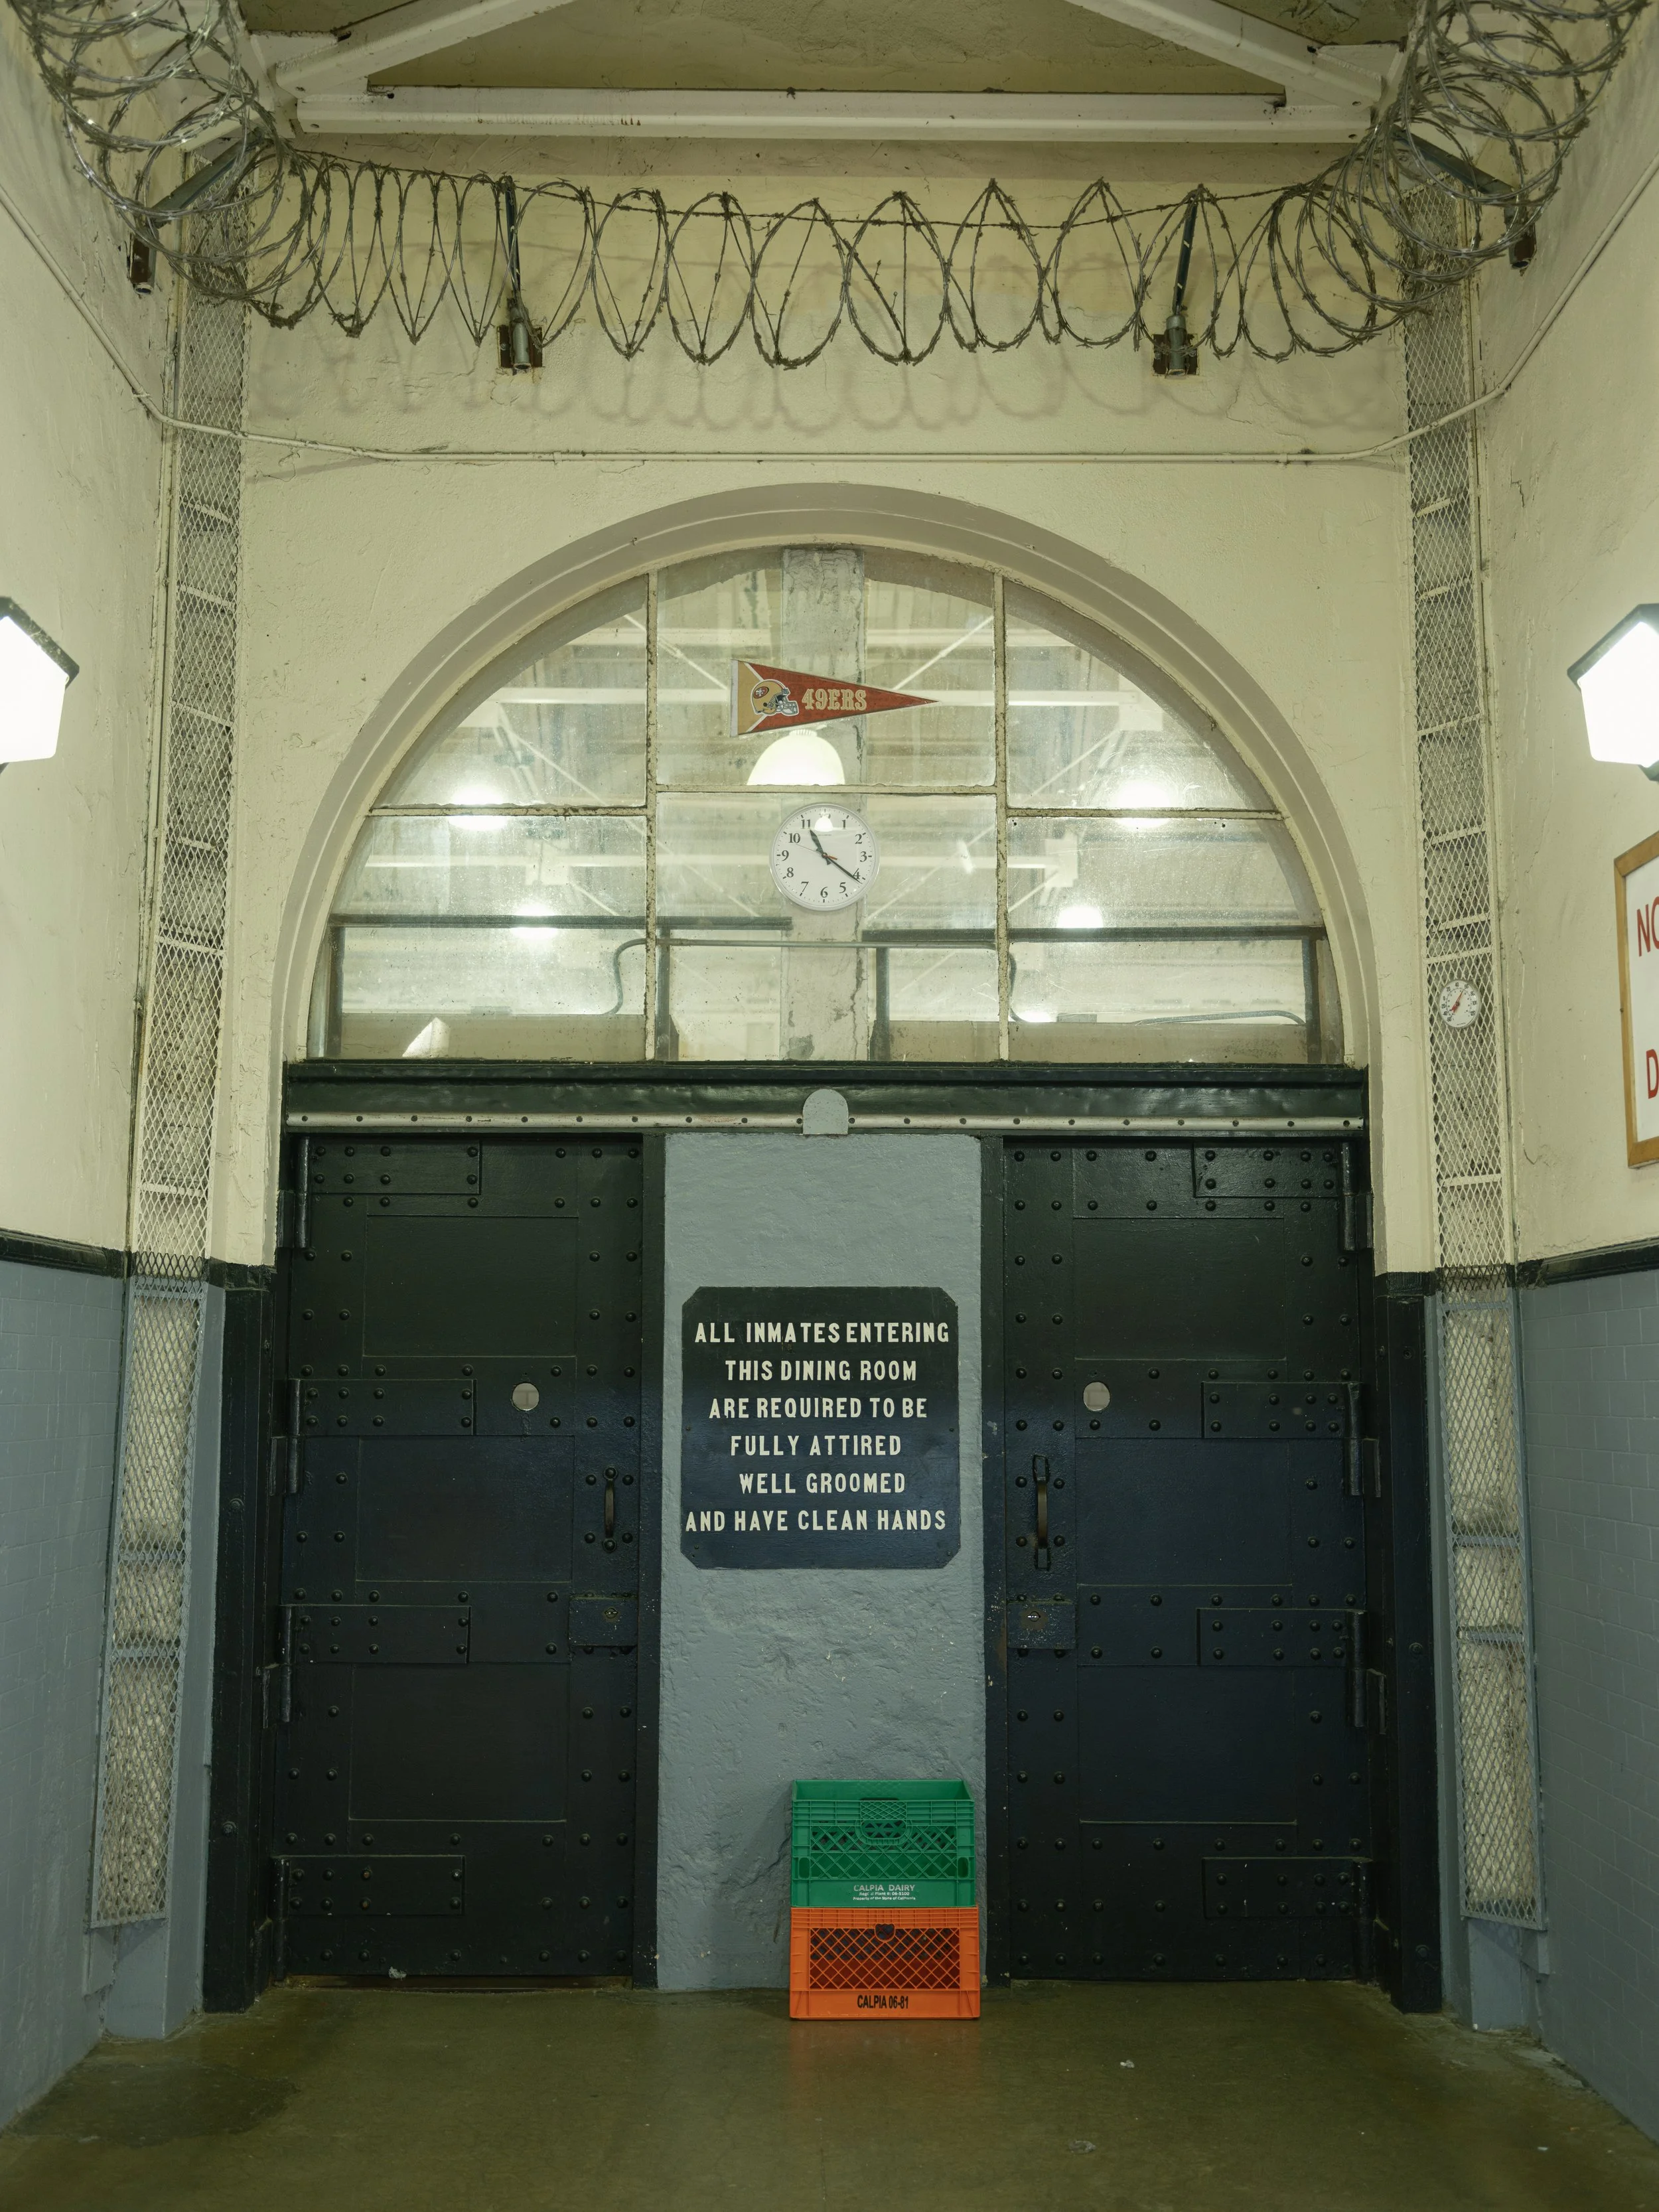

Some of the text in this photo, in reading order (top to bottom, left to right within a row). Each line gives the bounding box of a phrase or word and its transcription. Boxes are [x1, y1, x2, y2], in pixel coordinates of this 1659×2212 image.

[802, 688, 867, 711] 49ERS
[801, 819, 811, 829] 11
[841, 820, 847, 830] 1
[788, 833, 801, 844] 10
[855, 834, 863, 844] 2
[781, 850, 789, 861] 9
[859, 851, 867, 862] 3
[786, 867, 794, 877] 8
[852, 868, 861, 880] 4
[801, 881, 809, 893] 7
[820, 887, 828, 898] 6
[839, 882, 846, 893] 5
[694, 1322, 949, 1343] ALL INMATES ENTERING
[725, 1360, 916, 1381] THIS DINING ROOM
[709, 1397, 927, 1419] ARE REQUIRED TO BE
[731, 1435, 901, 1456] FULLY ATTIRED
[739, 1473, 905, 1495] WELL GROOMED
[685, 1509, 946, 1532] AND HAVE CLEAN HANDS
[857, 1994, 908, 2009] CALPIA 06-81
